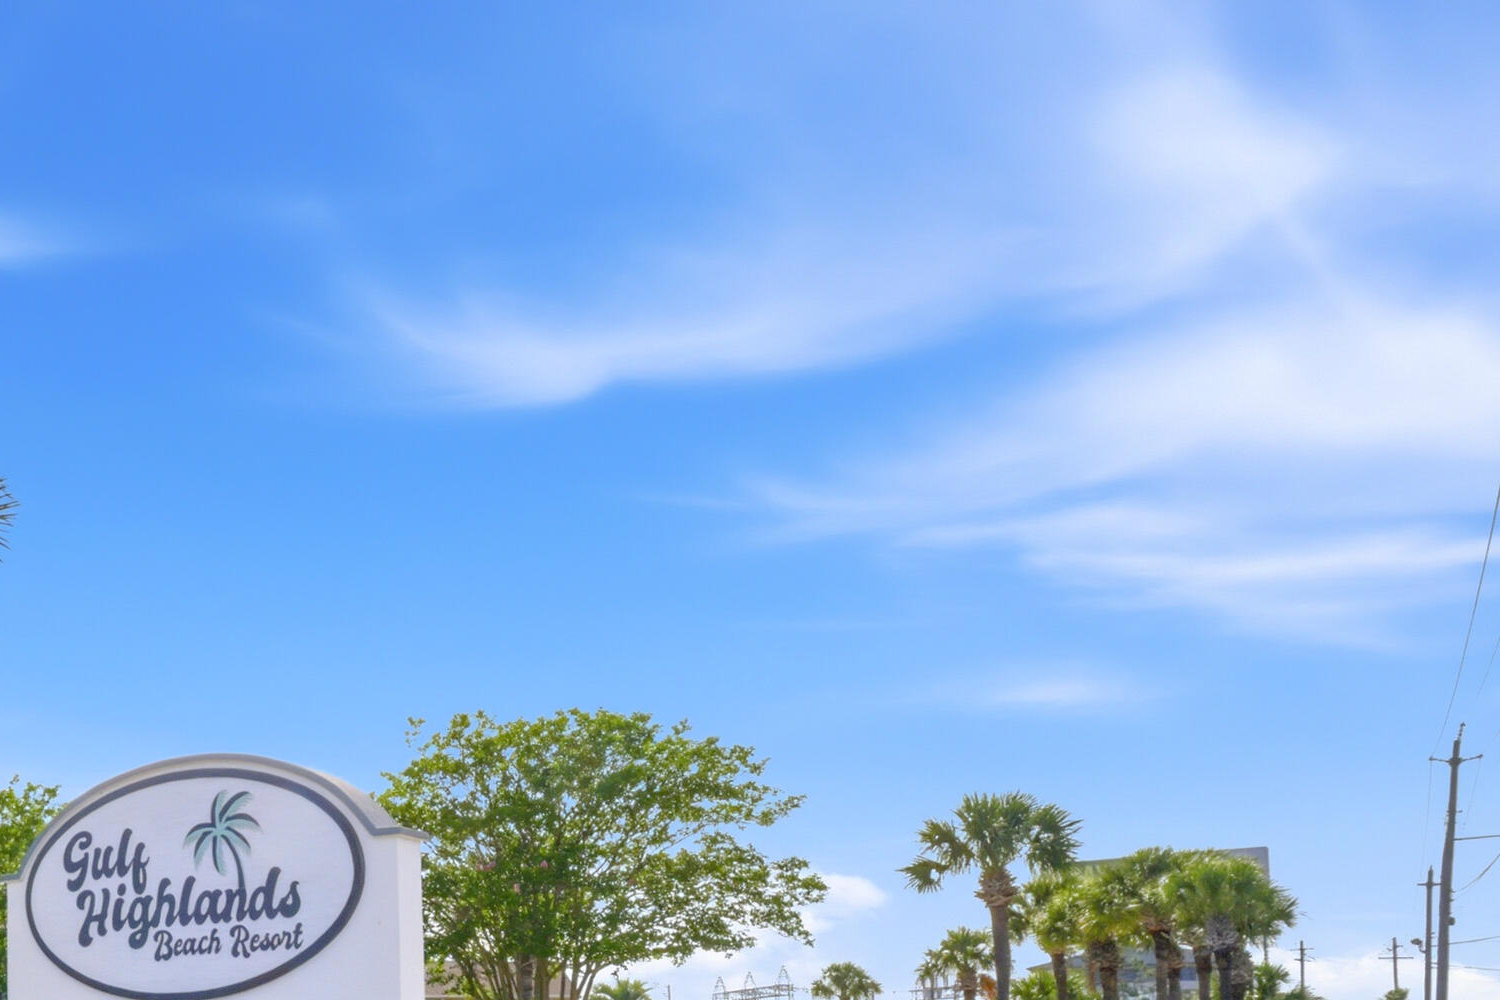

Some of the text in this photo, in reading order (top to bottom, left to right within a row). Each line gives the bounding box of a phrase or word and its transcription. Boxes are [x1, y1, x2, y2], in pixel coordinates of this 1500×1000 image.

[63, 828, 150, 895] Gulf
[76, 866, 301, 950] Highlands
[153, 922, 303, 962] Beach Resort
